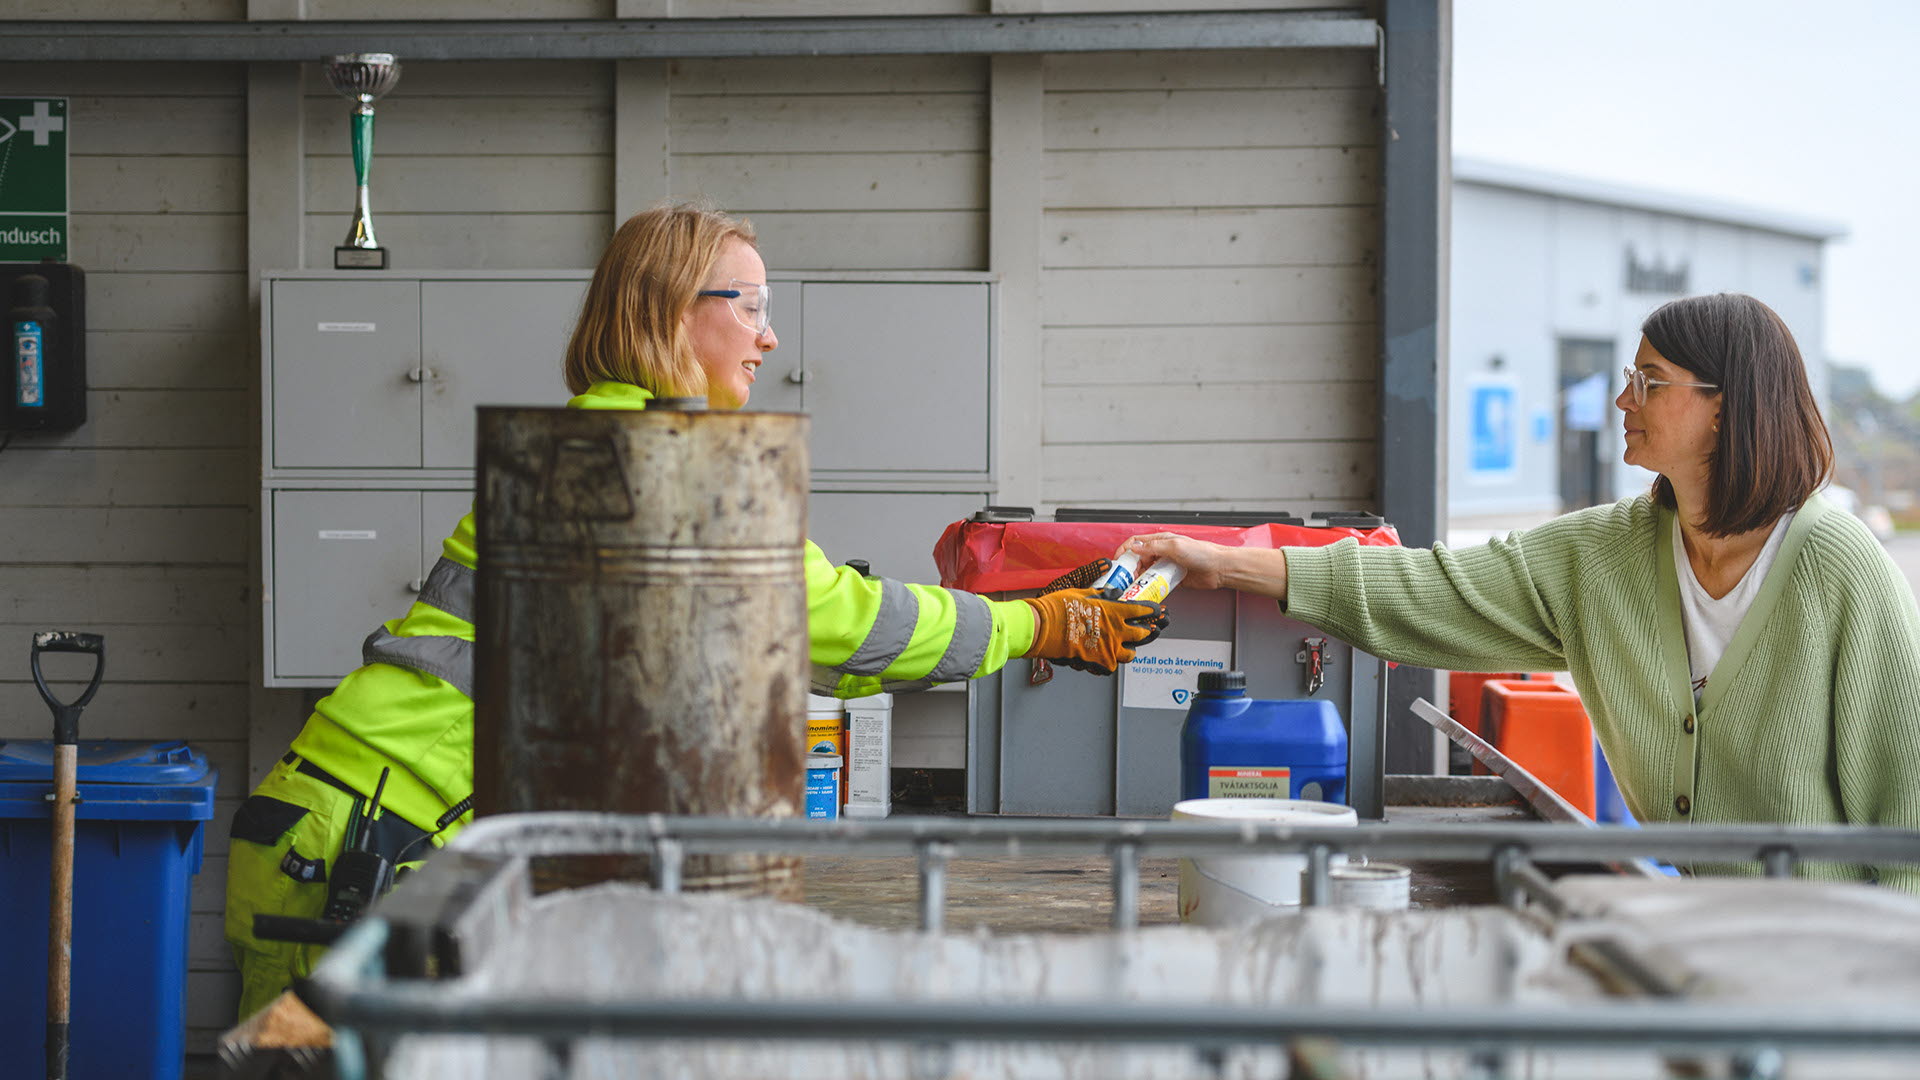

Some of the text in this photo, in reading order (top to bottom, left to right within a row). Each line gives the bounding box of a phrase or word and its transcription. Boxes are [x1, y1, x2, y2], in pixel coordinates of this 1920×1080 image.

[0, 226, 61, 245] ndusch
[1131, 656, 1224, 669] Avfall och återvinning
